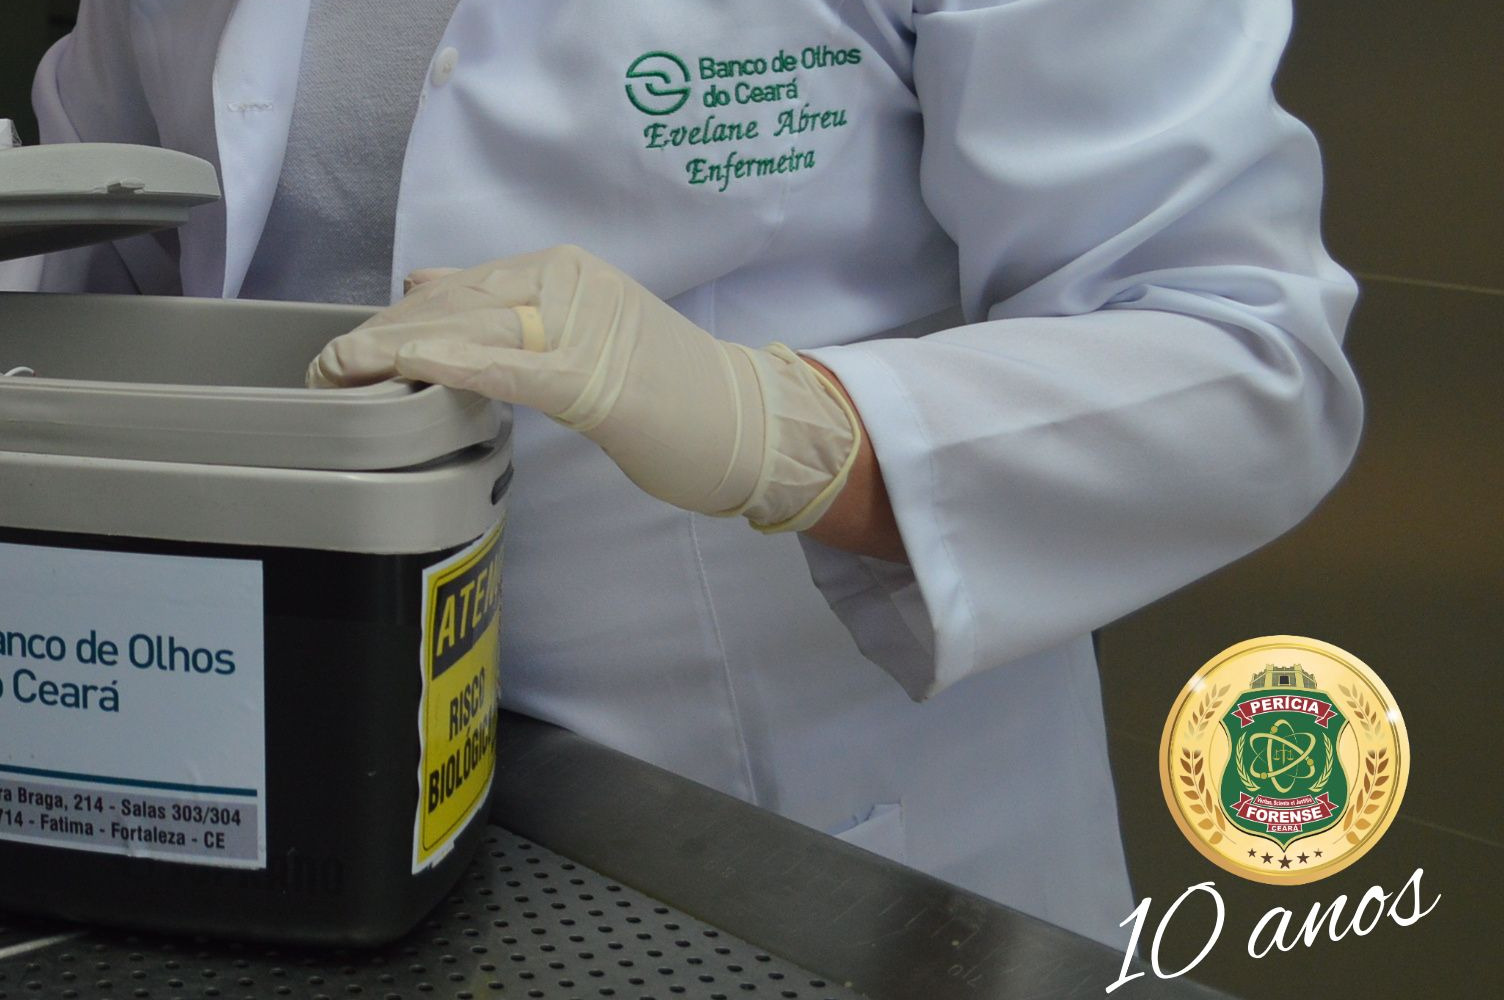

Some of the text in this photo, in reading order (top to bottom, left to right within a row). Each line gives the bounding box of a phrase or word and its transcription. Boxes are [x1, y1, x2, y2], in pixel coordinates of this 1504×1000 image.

[699, 45, 862, 80] Banco de Olhos
[703, 78, 798, 108] do Ceará
[644, 103, 848, 149] Evelane Abreu
[686, 147, 816, 193] Enfermeira
[76, 630, 119, 666] de
[128, 633, 236, 676] Olhos
[12, 668, 120, 712] Ceará
[449, 666, 486, 742] RISCO
[17, 787, 69, 811] Braga,
[73, 794, 104, 813] 214
[121, 799, 166, 820] Salas
[172, 803, 241, 826] 303/304
[40, 813, 94, 836] Fatima
[111, 822, 186, 846] Fortaleza
[204, 831, 226, 850] CE
